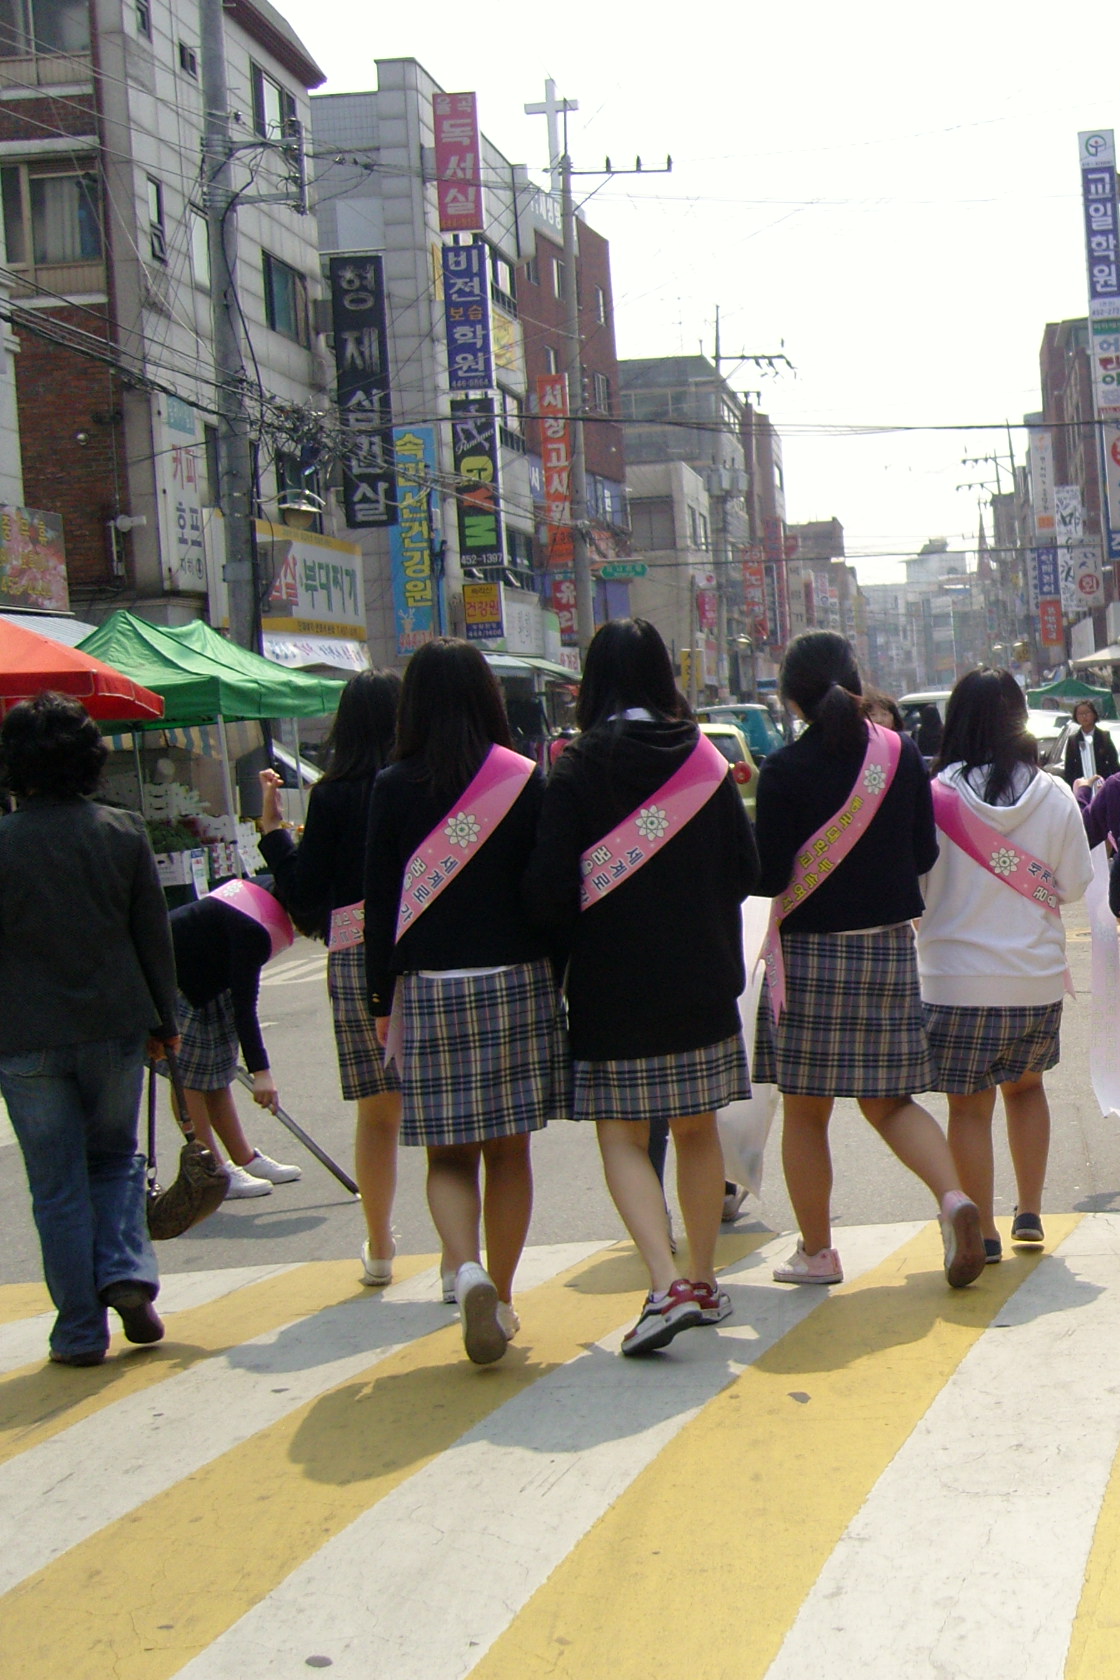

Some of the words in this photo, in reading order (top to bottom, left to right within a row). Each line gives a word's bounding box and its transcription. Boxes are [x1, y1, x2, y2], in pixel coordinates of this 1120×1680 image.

[440, 118, 477, 215] 독서실
[1087, 171, 1118, 293] 교일학원
[450, 305, 484, 321] 보습
[460, 553, 503, 565] 452-1397
[466, 601, 500, 617] 건강원
[412, 855, 459, 905] 세계로
[592, 847, 644, 891] 세계로
